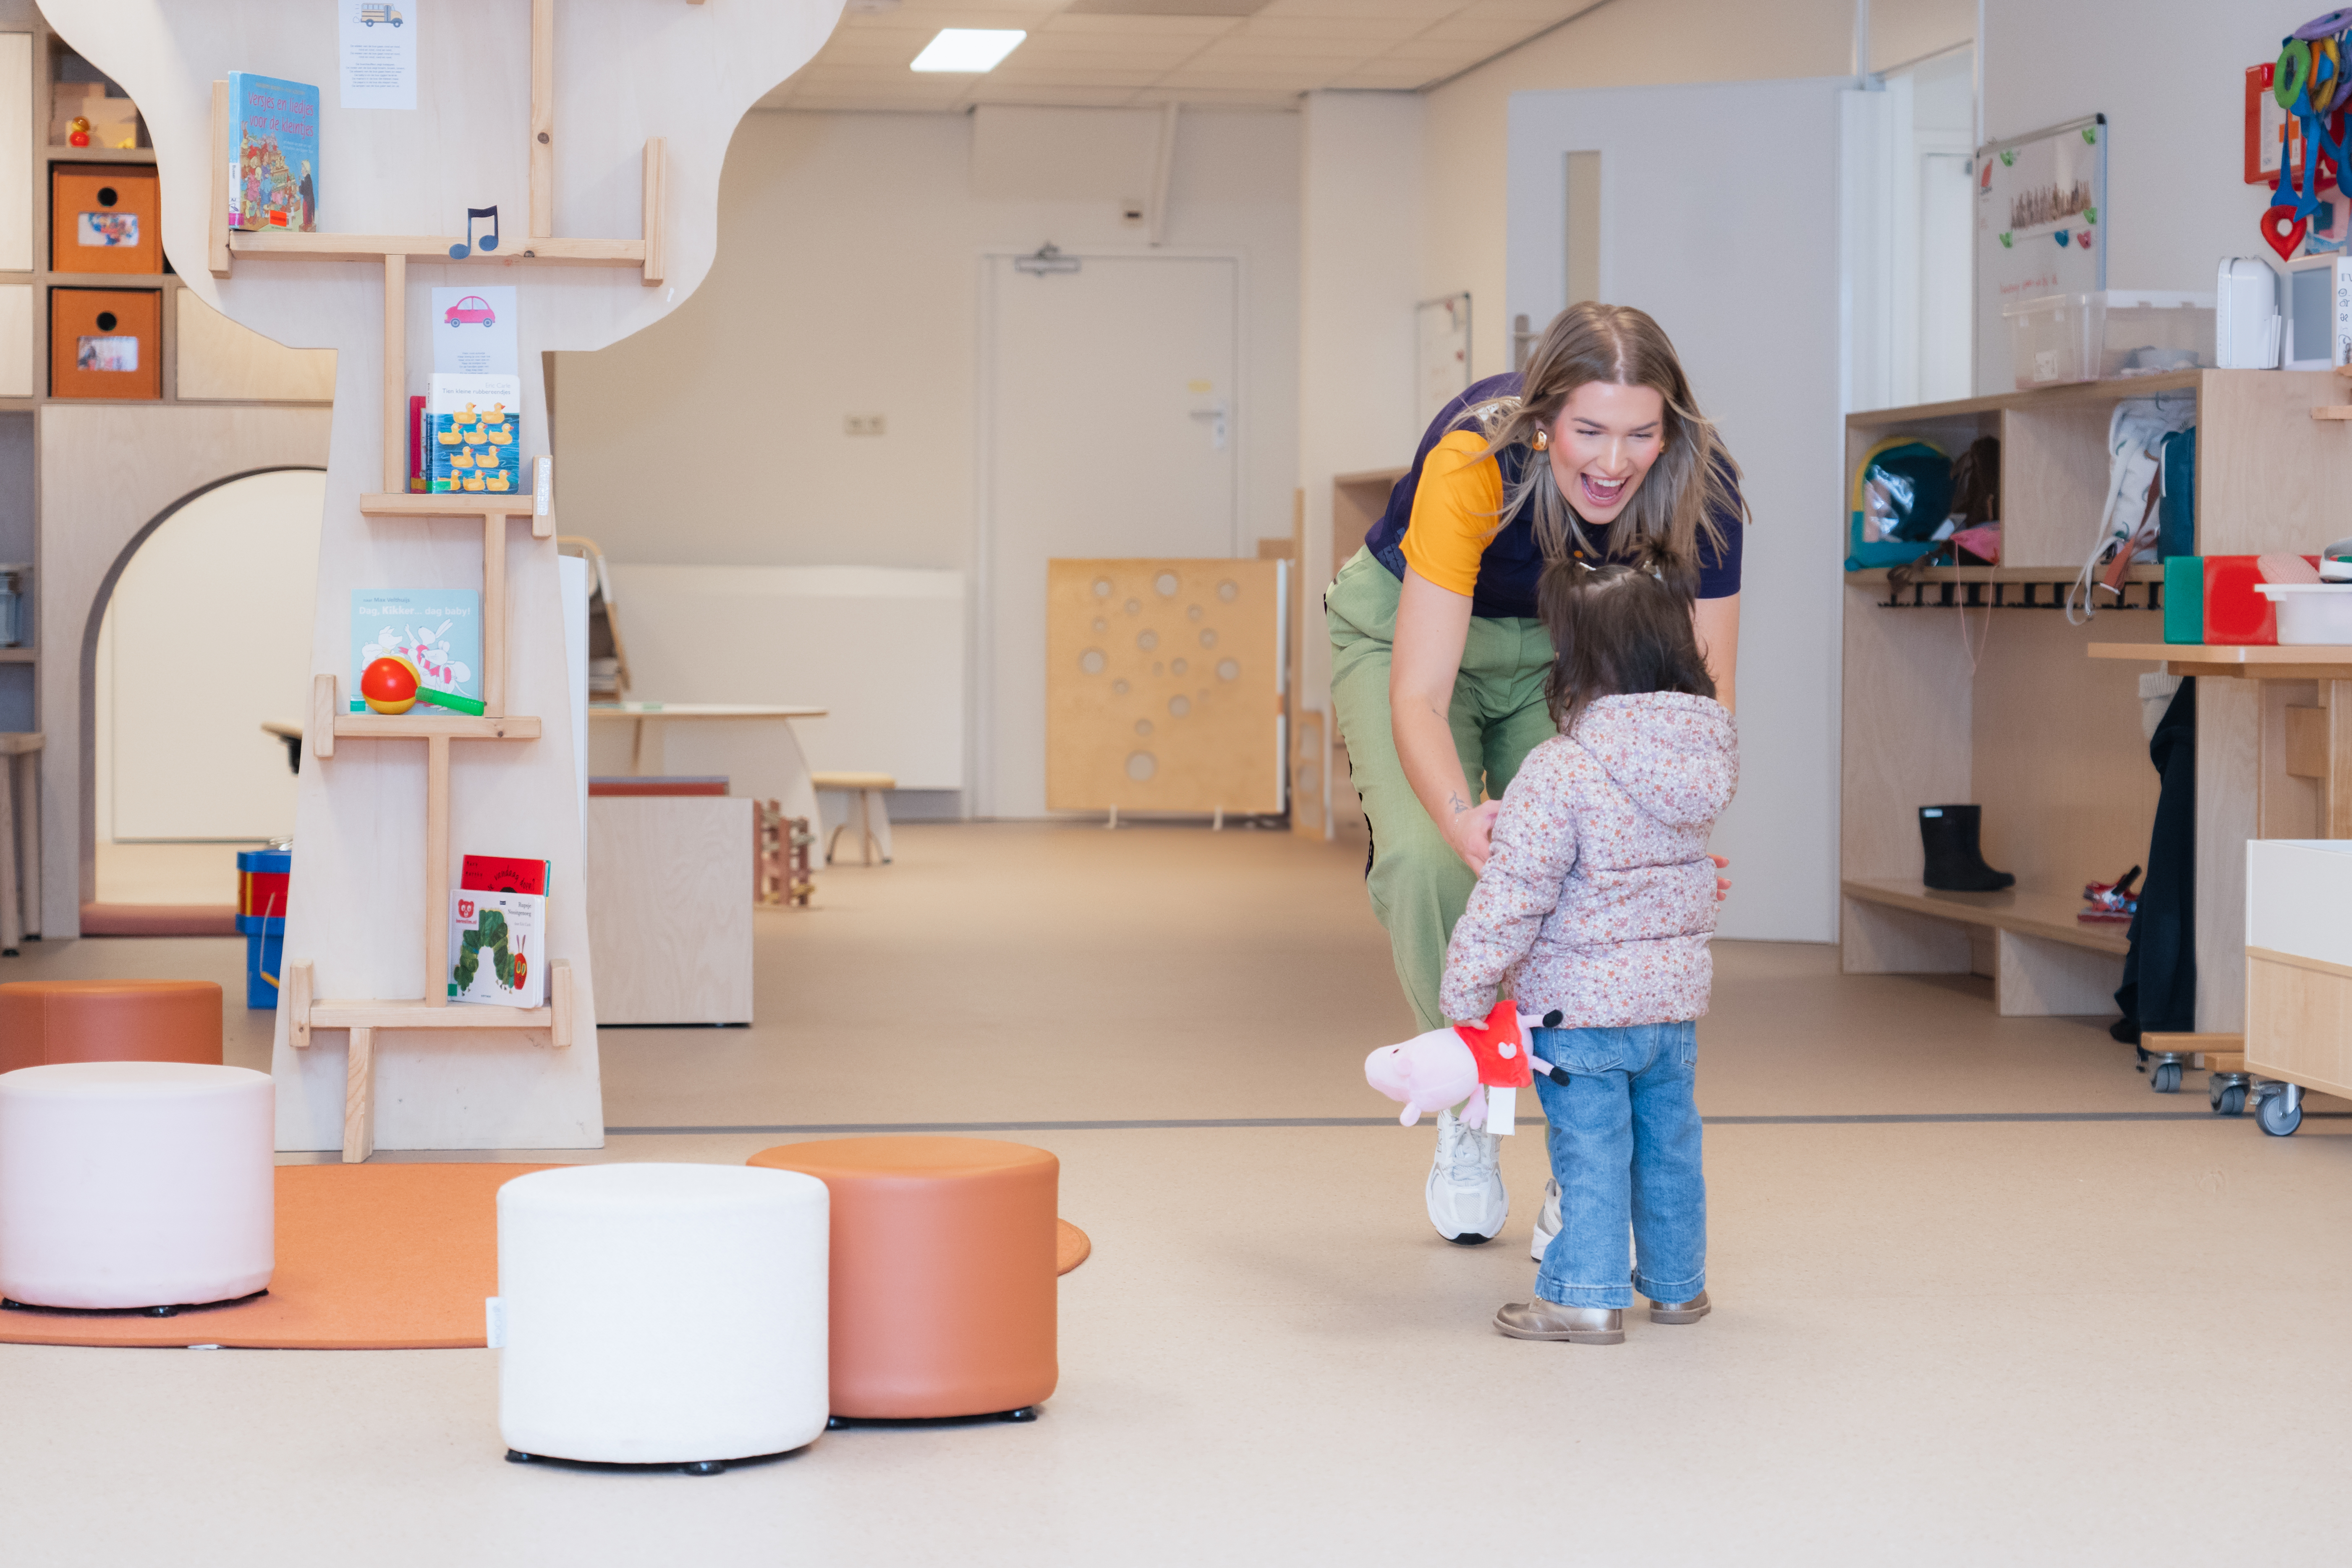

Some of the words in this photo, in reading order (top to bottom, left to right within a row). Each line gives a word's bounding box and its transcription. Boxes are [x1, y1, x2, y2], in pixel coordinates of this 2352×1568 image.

[249, 92, 274, 112] Versjes
[277, 99, 287, 110] en
[289, 97, 314, 119] liedjes
[249, 115, 267, 128] voor
[269, 115, 279, 131] de
[282, 117, 313, 139] kleintjes
[359, 607, 380, 616] Dag,
[425, 607, 441, 616] dag
[445, 607, 470, 616] baby!
[494, 865, 519, 884] vandaag
[520, 878, 535, 891] doen?
